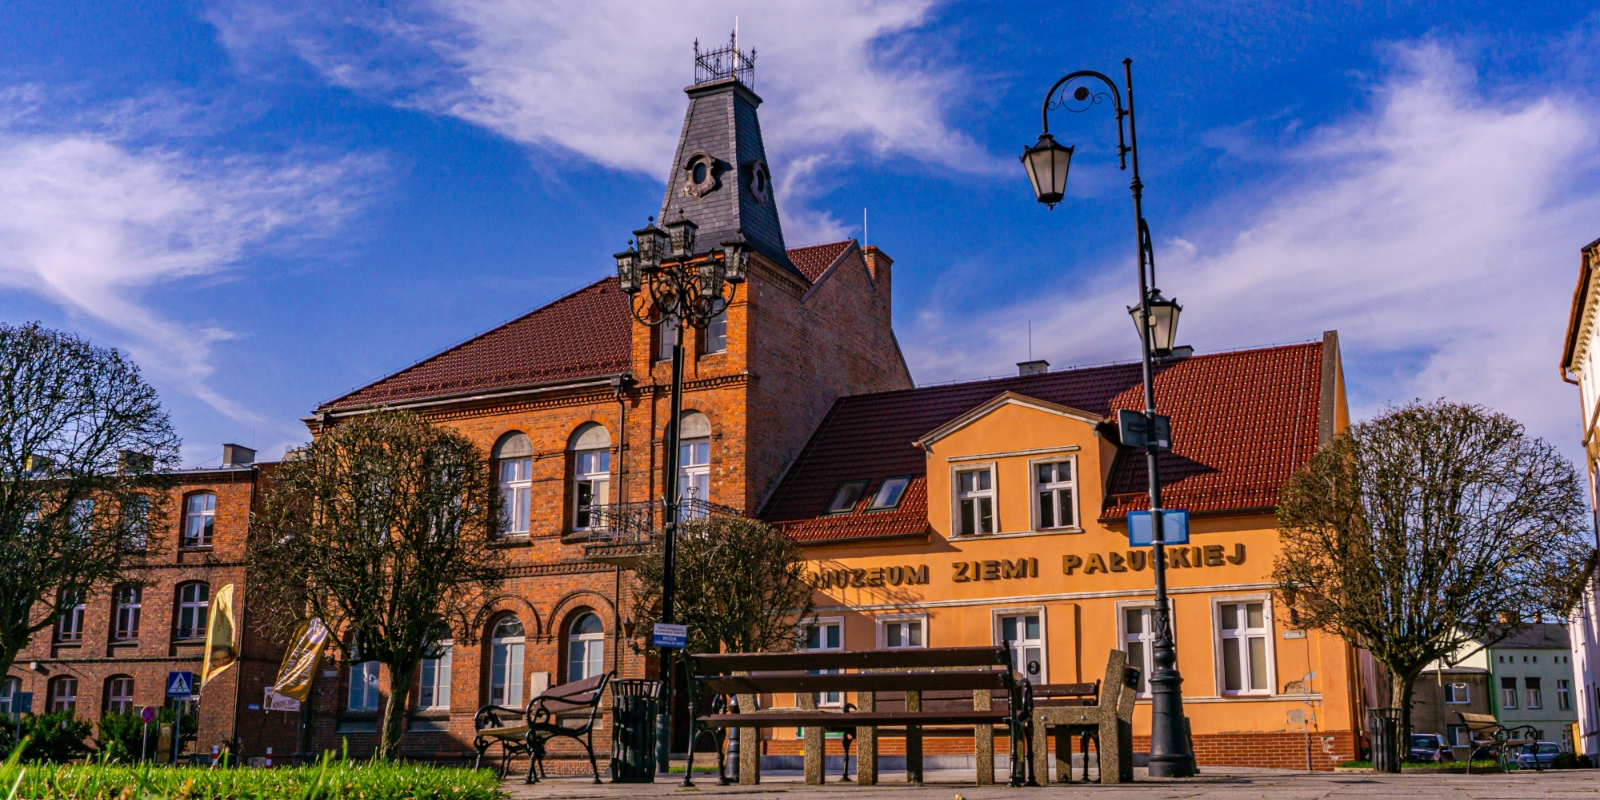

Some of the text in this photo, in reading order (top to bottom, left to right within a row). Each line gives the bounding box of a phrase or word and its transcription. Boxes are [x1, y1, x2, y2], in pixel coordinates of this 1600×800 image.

[808, 543, 1246, 589] MUZEUM ZIEMI PAŁUCKIEJ
